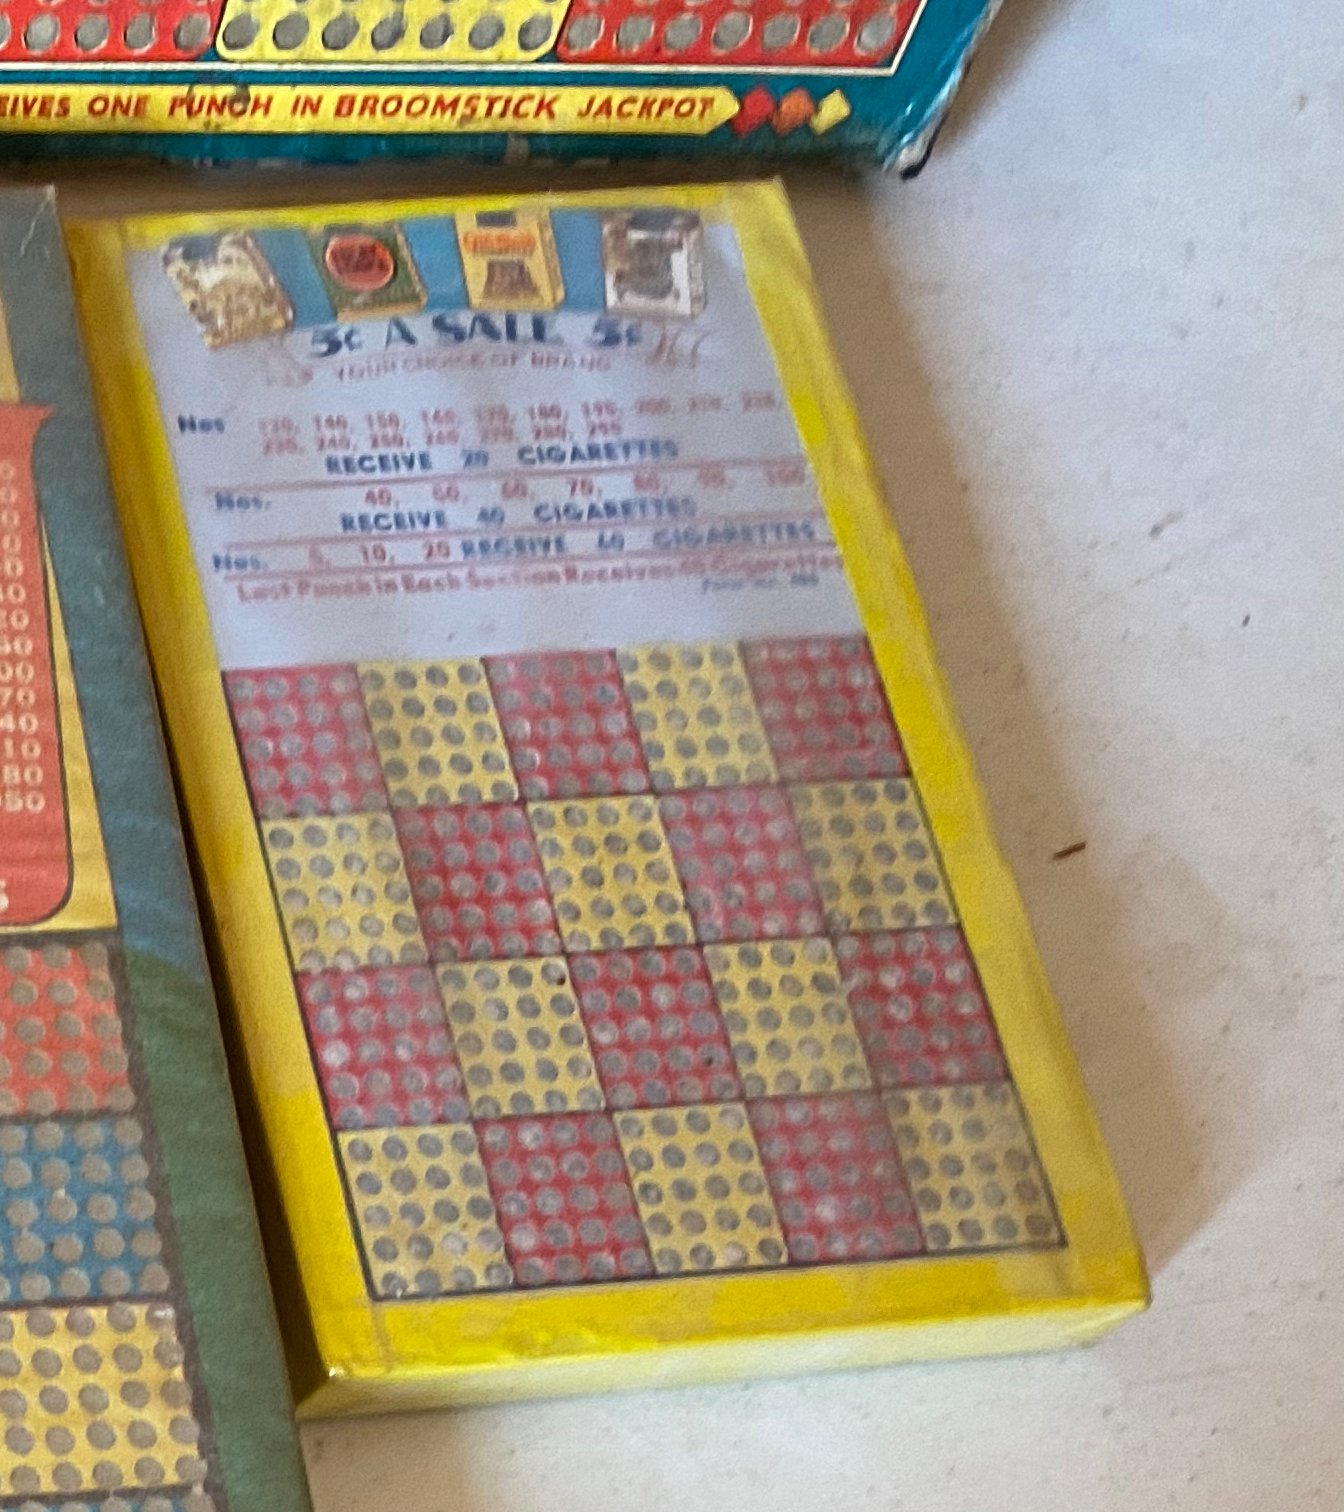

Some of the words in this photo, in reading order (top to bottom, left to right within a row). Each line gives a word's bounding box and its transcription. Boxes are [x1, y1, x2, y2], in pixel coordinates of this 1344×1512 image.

[88, 94, 148, 118] ONE
[168, 94, 274, 120] PUNCH
[291, 94, 319, 118] IN
[335, 94, 557, 120] BROOMSTICK
[577, 94, 714, 120] JACKPOT
